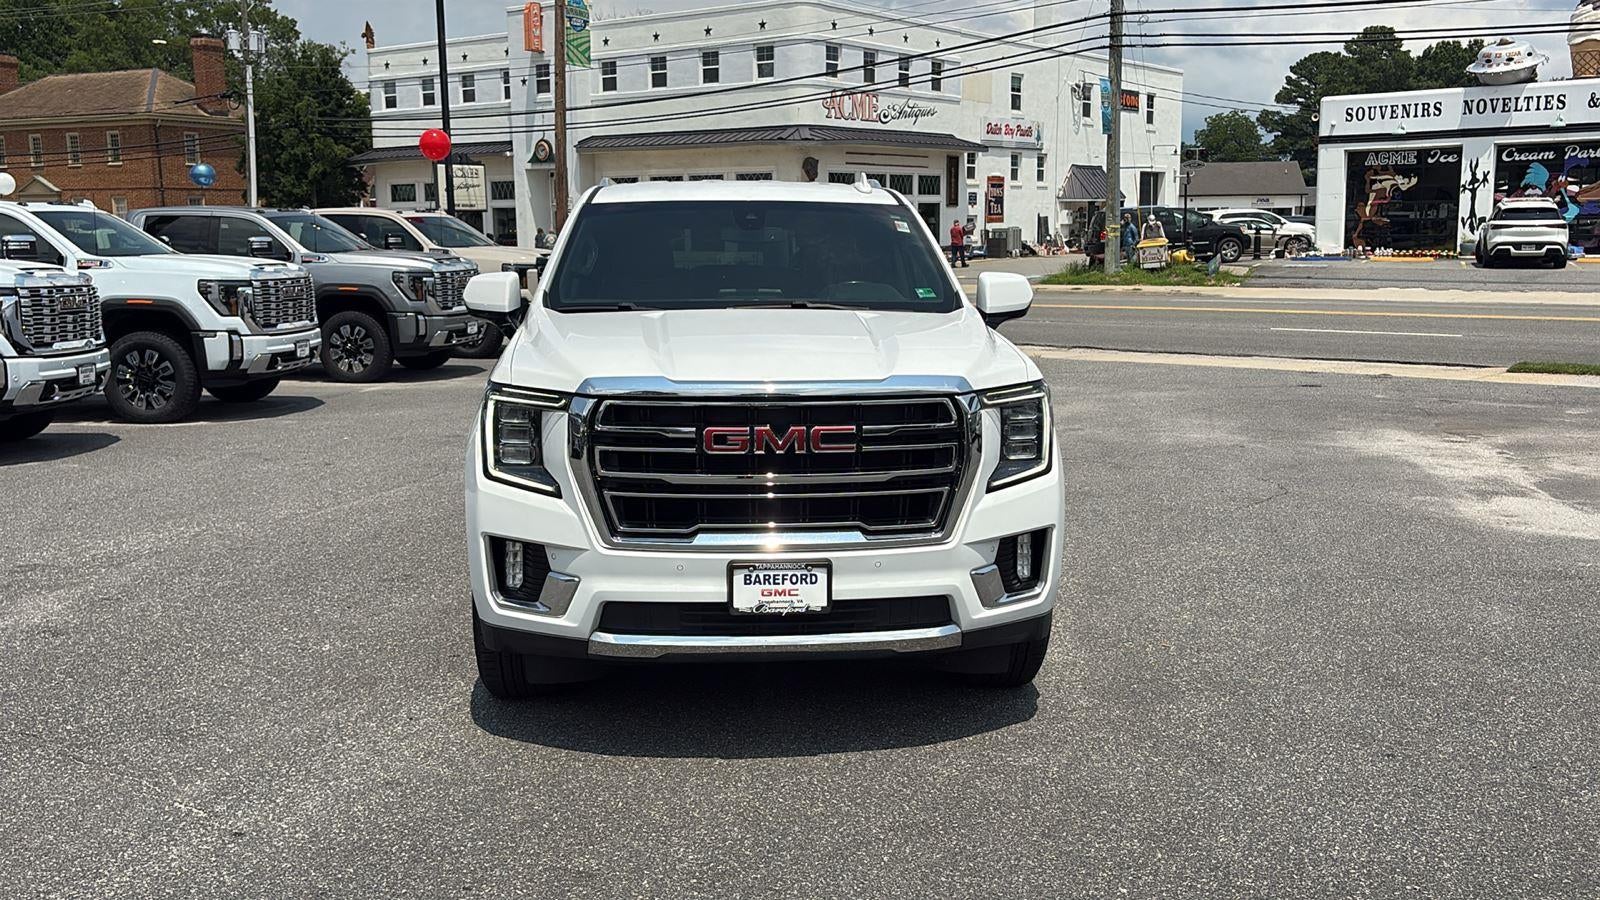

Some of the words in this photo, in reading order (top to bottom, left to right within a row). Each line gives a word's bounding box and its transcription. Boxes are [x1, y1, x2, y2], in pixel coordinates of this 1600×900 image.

[822, 89, 880, 122] ACME
[880, 97, 938, 125] Antiques
[1345, 101, 1443, 122] SOUVENIRS
[1462, 93, 1567, 115] NOVELTIES
[986, 122, 1003, 135] Dutch
[1004, 123, 1015, 139] Boy
[1015, 124, 1033, 138] Paints
[1365, 151, 1417, 166] ACME
[1427, 149, 1459, 164] Ice
[1501, 147, 1557, 162] Cream
[990, 202, 1002, 214] TEA
[703, 425, 857, 454] GMC
[743, 573, 818, 586] BAREFORD
[761, 588, 800, 597] GMC
